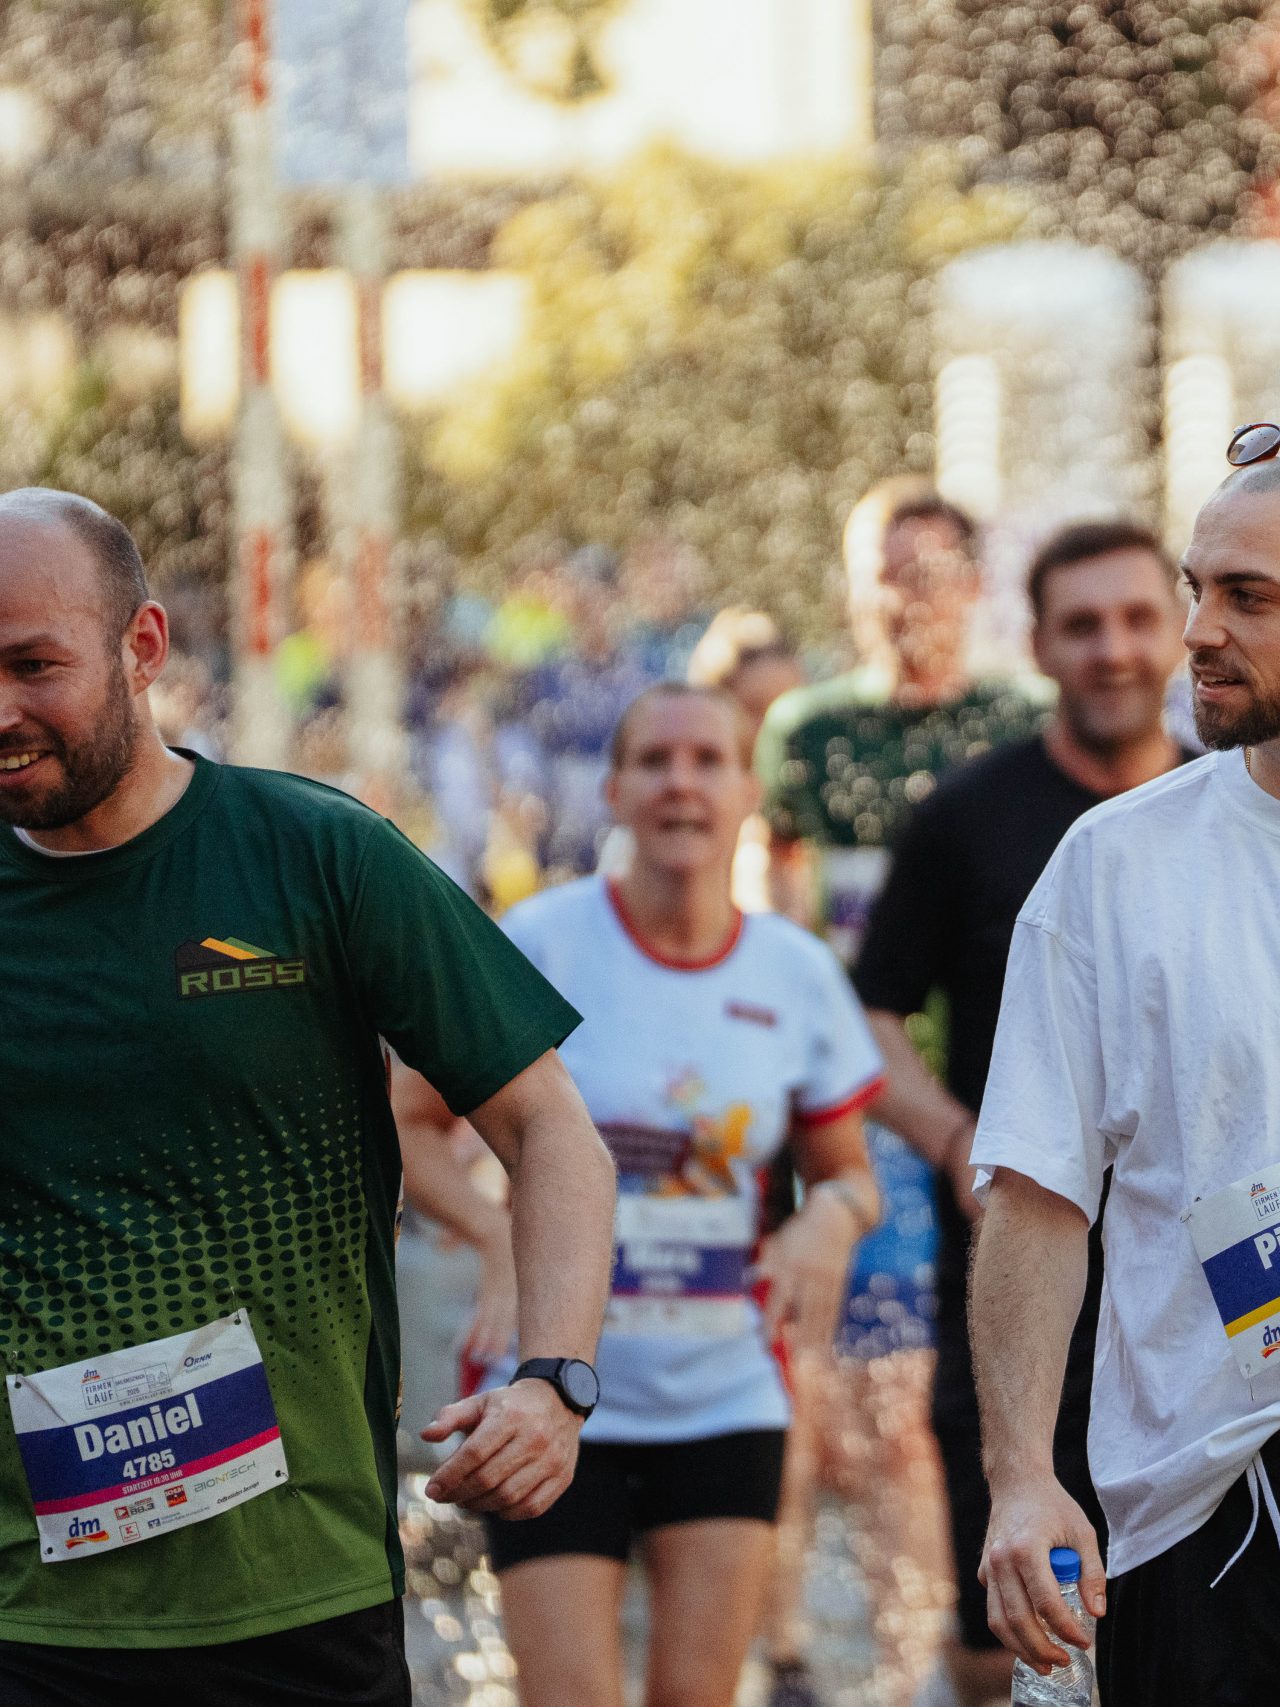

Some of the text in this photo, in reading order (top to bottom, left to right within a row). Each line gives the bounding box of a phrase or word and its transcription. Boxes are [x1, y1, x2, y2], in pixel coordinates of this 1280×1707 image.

[181, 961, 304, 996] ROSS
[1254, 1191, 1278, 1206] FIRMEN
[1257, 1200, 1280, 1217] LAUF
[85, 1381, 113, 1394] FIRMEN
[87, 1390, 114, 1406] LAUF
[73, 1393, 203, 1462] Daniel
[122, 1448, 176, 1480] 4785
[194, 1460, 256, 1493] BIONTECH
[122, 1479, 153, 1495] STARTZEIT
[68, 1517, 101, 1538] dm
